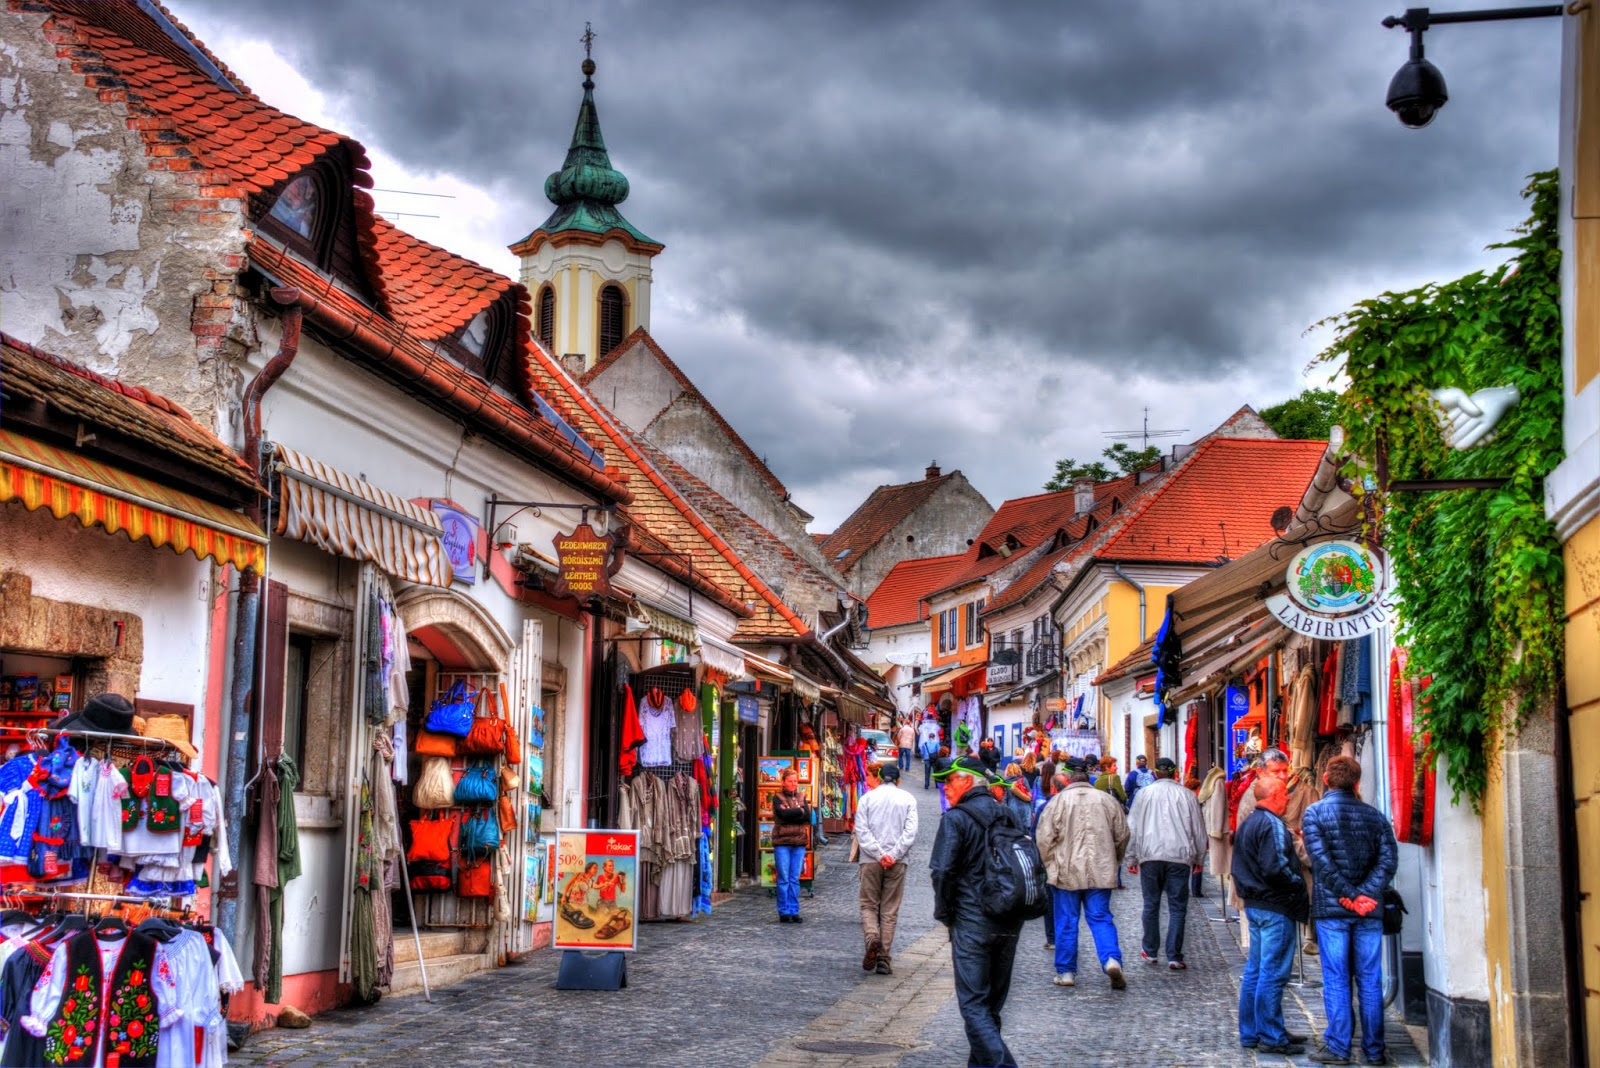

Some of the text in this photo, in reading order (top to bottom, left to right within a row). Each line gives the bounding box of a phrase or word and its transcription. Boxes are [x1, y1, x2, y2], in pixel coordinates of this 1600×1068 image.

[560, 541, 607, 550] LEDERWAREN
[564, 571, 597, 580] LEATHER
[568, 582, 592, 590] GOODS
[1277, 598, 1395, 636] LABIRINTUS
[558, 854, 584, 866] 50%
